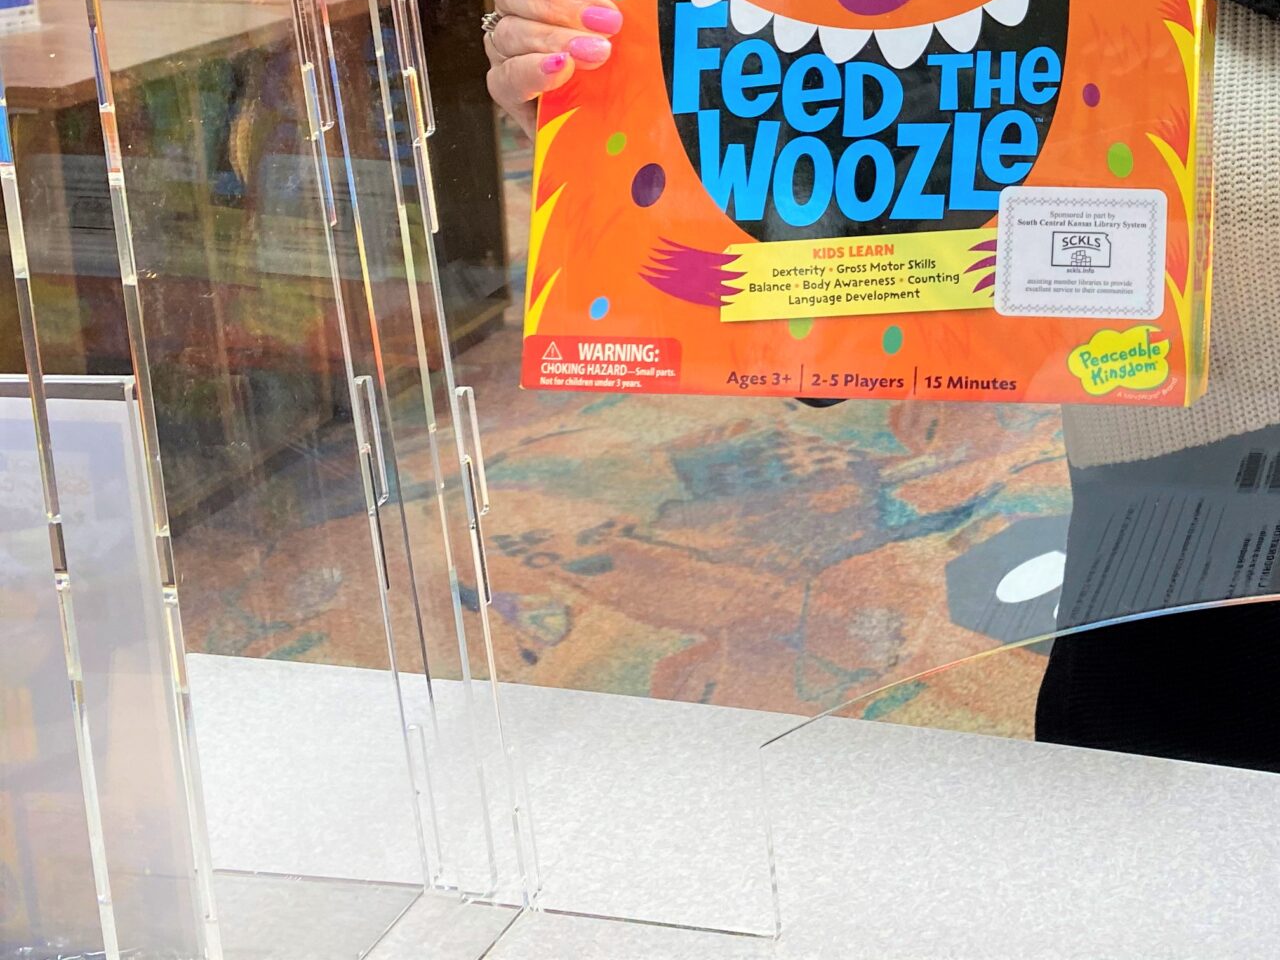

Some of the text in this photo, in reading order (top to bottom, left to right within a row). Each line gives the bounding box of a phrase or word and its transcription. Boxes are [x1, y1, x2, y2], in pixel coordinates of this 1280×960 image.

[1050, 211, 1084, 219] Sponsored
[1093, 212, 1106, 220] part
[1107, 212, 1116, 220] by
[1039, 219, 1066, 227] Central
[1094, 220, 1121, 229] Library
[1123, 221, 1147, 229] System
[1062, 235, 1101, 248] SCKLS
[812, 244, 895, 259] KIDS LEARN
[772, 258, 936, 279] Dexterity Gross Motor Skills
[749, 272, 960, 293] Balance Body Awareness Counting
[788, 288, 920, 307] Language Development
[578, 343, 659, 362] WARNING:
[1080, 337, 1161, 369] Peaceable
[541, 362, 585, 375] CHOKING
[656, 368, 676, 378] parts.
[1091, 362, 1157, 386] Kingdom
[539, 377, 642, 389] Not for children under 3 years.
[726, 371, 792, 387] Ages 3+
[811, 373, 904, 391] 2-5 Players
[924, 376, 1017, 391] 15 Minutes
